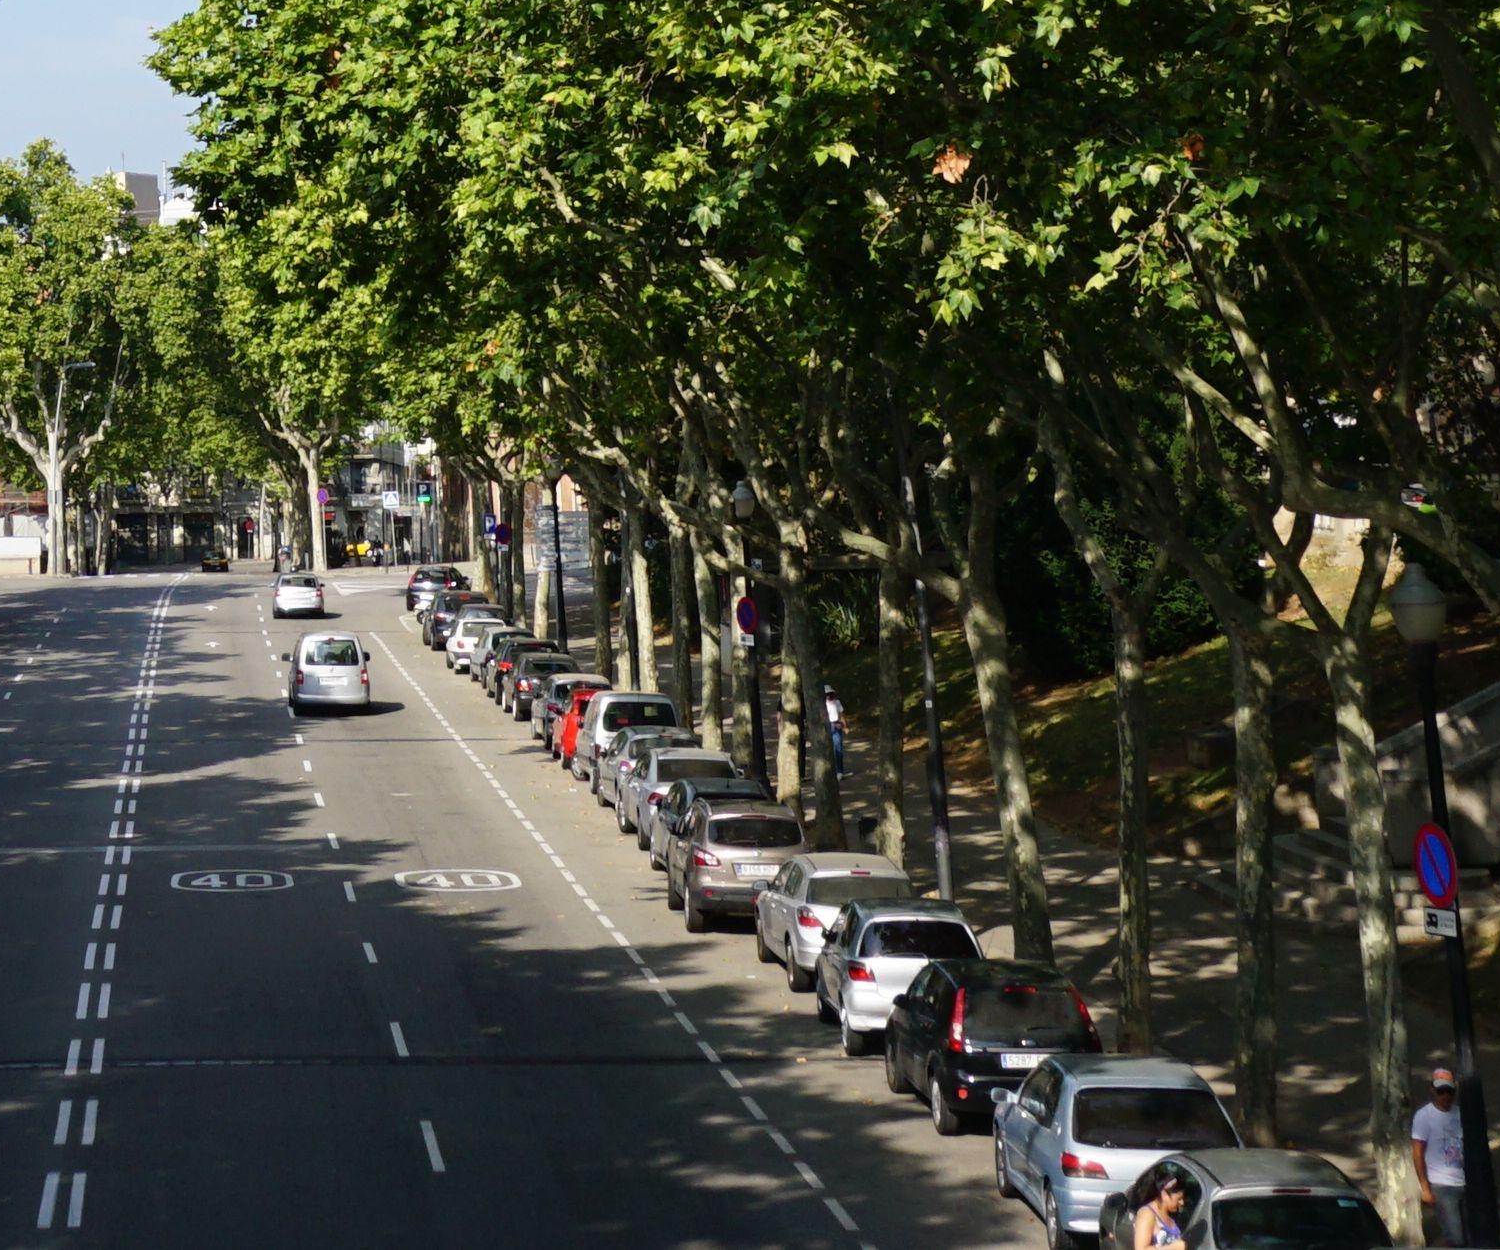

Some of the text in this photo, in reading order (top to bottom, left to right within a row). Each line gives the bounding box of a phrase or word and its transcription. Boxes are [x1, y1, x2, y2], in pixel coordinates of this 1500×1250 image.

[485, 516, 494, 532] P
[190, 873, 274, 888] 40
[417, 873, 502, 888] 40
